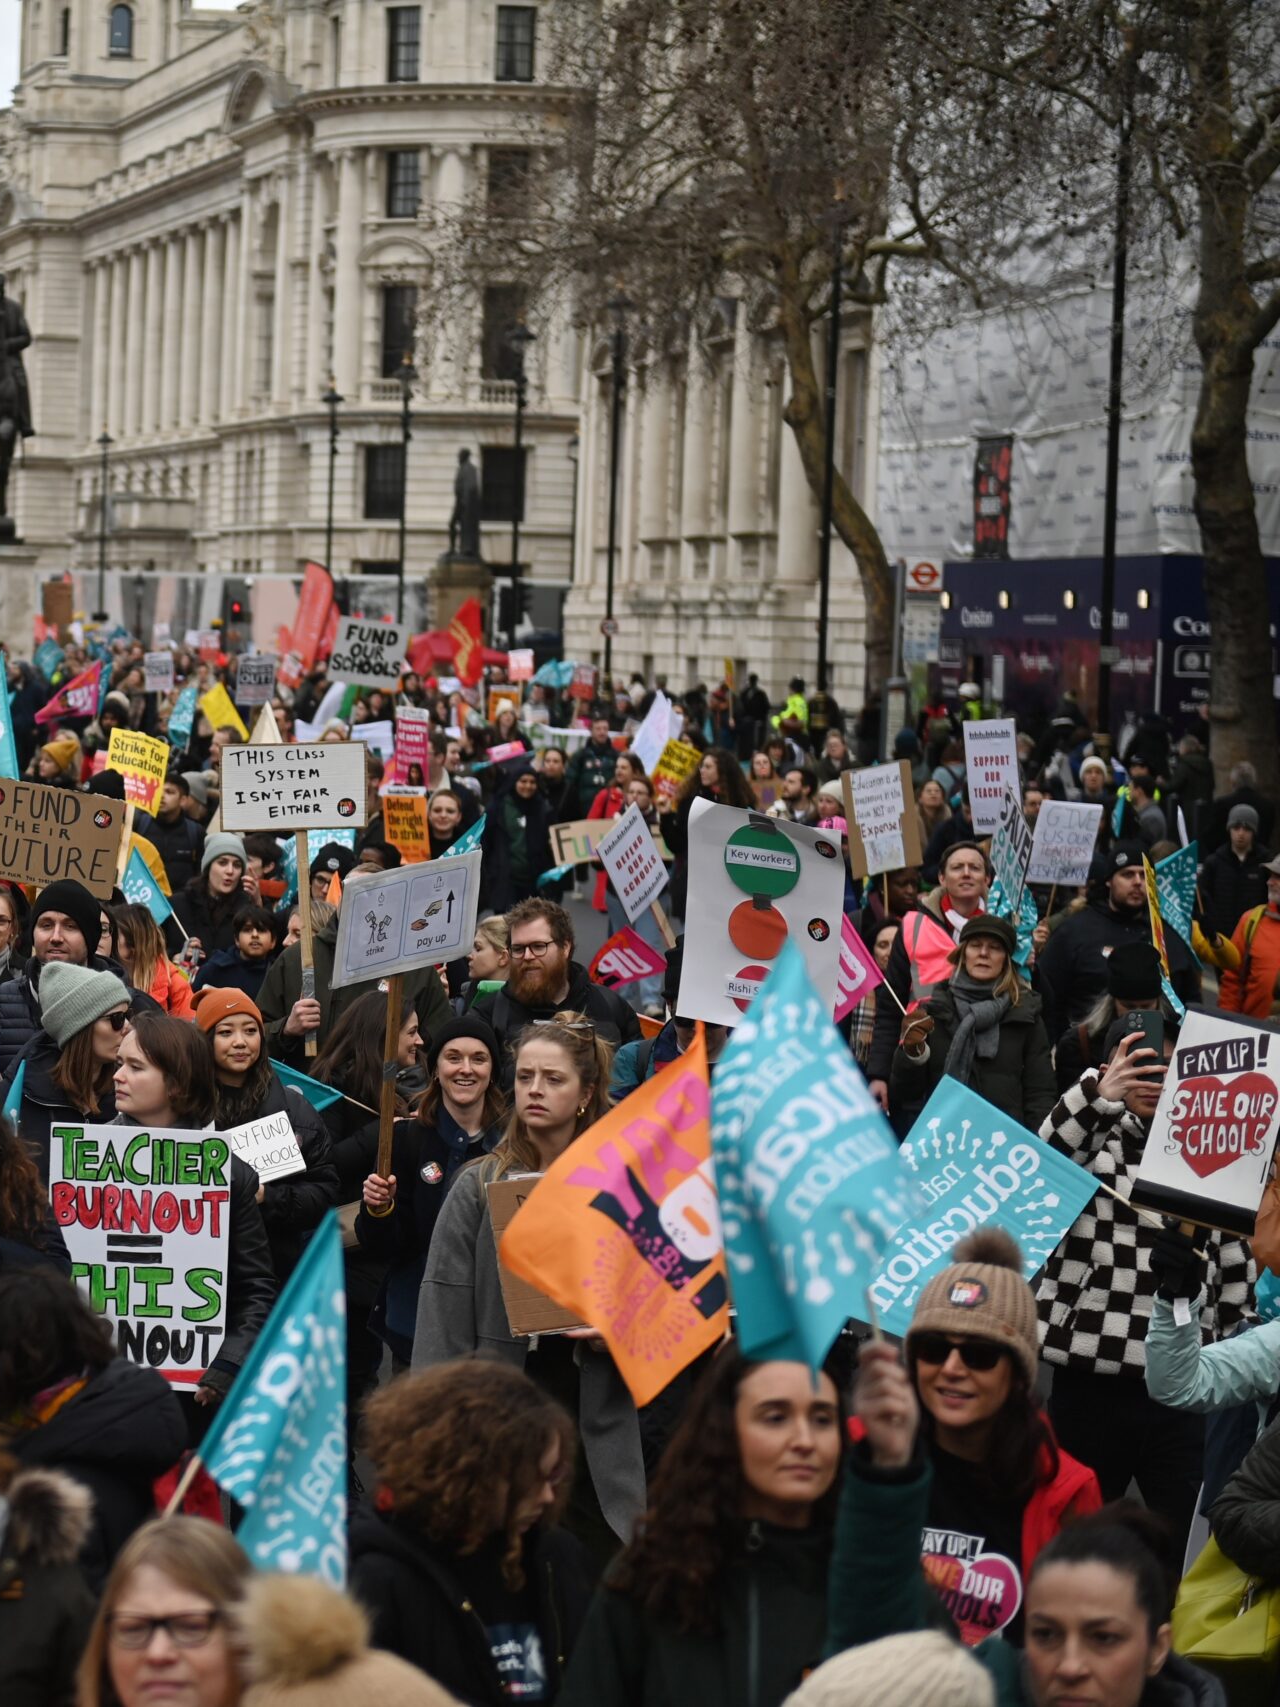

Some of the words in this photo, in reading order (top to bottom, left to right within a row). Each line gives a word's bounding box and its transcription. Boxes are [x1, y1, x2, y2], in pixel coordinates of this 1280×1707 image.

[346, 625, 398, 646] FUND
[350, 643, 384, 662] OUR
[332, 653, 401, 679] SCHOOLS
[113, 737, 147, 756] Strike
[150, 748, 166, 764] for
[229, 750, 274, 767] THIS
[973, 755, 1010, 767] SUPPORT
[111, 753, 163, 778] education
[255, 769, 320, 783] SYSTEM
[985, 771, 1001, 782] OUR
[235, 789, 283, 805] ISN'T
[293, 788, 329, 801] FAIR
[974, 787, 1003, 798] TEACHE
[13, 786, 81, 825] FUND
[269, 804, 322, 819] EITHER
[386, 798, 415, 811] Defend
[4, 815, 70, 841] THEIR
[388, 814, 401, 825] the
[402, 813, 423, 829] right
[1047, 806, 1099, 831] GIVE
[389, 829, 399, 839] to
[400, 828, 424, 841] strike
[1043, 831, 1064, 843] US
[1071, 832, 1094, 844] OUR
[616, 834, 644, 871] DEFEND
[731, 849, 749, 861] Key
[752, 853, 792, 866] workers
[627, 853, 644, 874] OUR
[623, 853, 657, 897] SCHOOLS
[365, 945, 385, 956] strike
[416, 937, 431, 949] pay
[434, 933, 447, 945] up
[728, 982, 751, 994] Rishi
[1183, 1045, 1221, 1074] PAY
[1167, 1089, 1228, 1120] SAVE
[1233, 1092, 1274, 1121] OUR
[251, 1117, 290, 1145] FUND
[1164, 1121, 1265, 1157] SCHOOLS
[53, 1127, 230, 1186] TEACHER
[52, 1181, 229, 1238] BURNOUT
[922, 1533, 944, 1554] AY
[925, 1556, 958, 1588] AVE
[960, 1567, 1005, 1604] OUR
